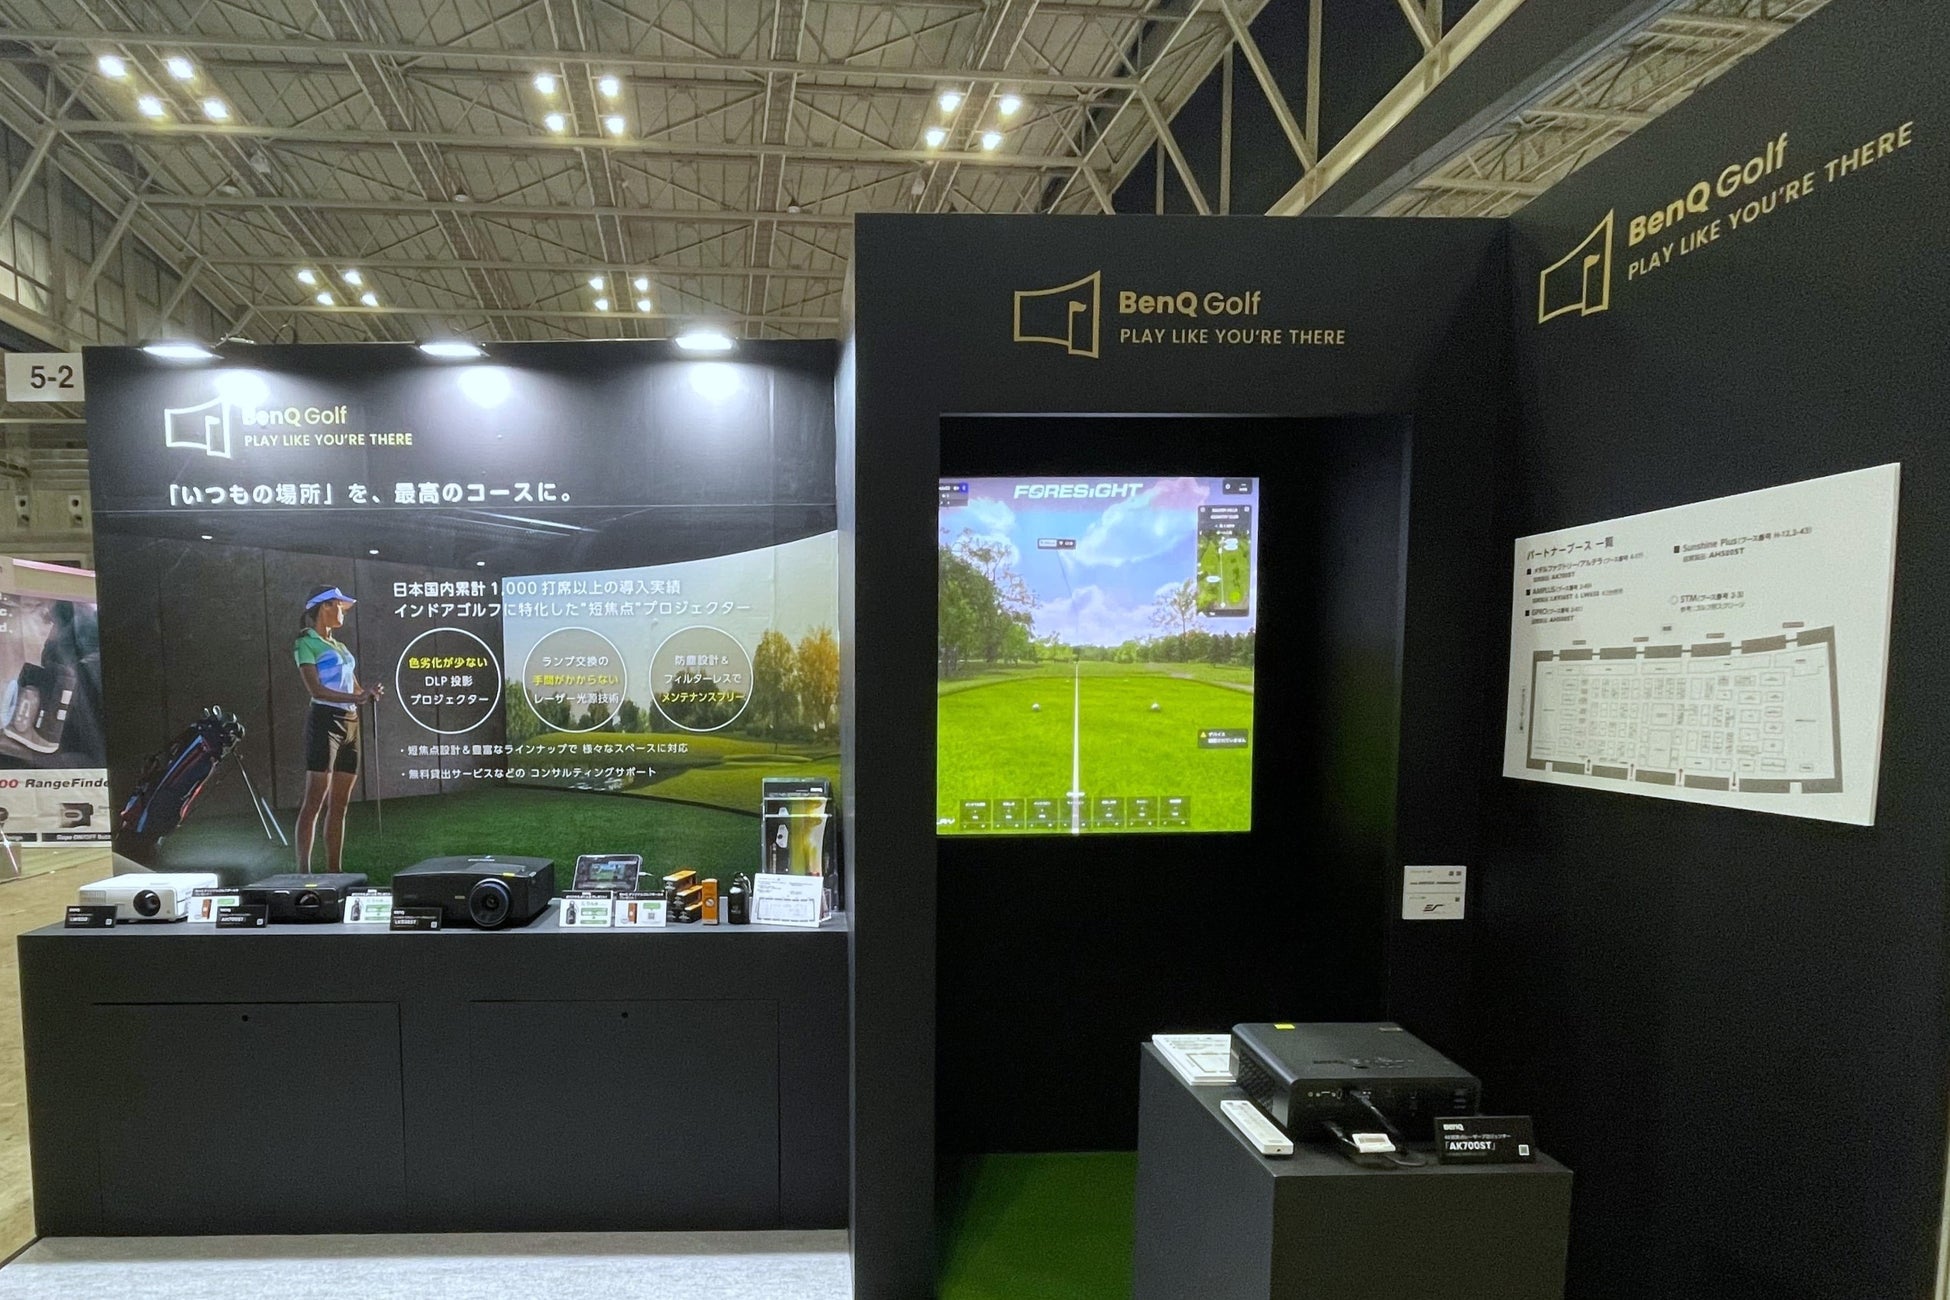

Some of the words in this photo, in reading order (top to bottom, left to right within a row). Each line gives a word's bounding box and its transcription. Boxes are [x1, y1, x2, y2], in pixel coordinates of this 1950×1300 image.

[1628, 180, 1711, 248] BenQ
[1717, 132, 1788, 199] Golf
[1628, 242, 1675, 281] PLAY
[1680, 220, 1722, 256] LIKE
[1729, 172, 1815, 231] YOU'RE
[1824, 121, 1914, 183] THERE
[1119, 291, 1198, 318] BenQ
[1204, 290, 1261, 316] Golf
[1120, 329, 1164, 344] PLAY
[1172, 329, 1208, 344] LIKE
[1216, 329, 1282, 345] YOU'RE
[1289, 330, 1346, 345] THERE
[30, 365, 74, 389] 5-2
[304, 405, 348, 425] Golf
[244, 434, 278, 447] PLAY
[283, 434, 310, 446] LIKE
[315, 433, 365, 446] YOU'RE
[369, 432, 413, 446] THERE
[169, 482, 332, 506] 「いつもの場所」
[348, 483, 381, 504] を、
[394, 482, 573, 505] 最高のコースに。
[393, 581, 486, 598] 日本国内累計
[490, 580, 537, 597] 1,000
[541, 578, 681, 596] 打席以上の導入実績
[408, 656, 488, 669] 色劣化が少ない
[541, 655, 609, 667] ランプ交換の
[425, 676, 447, 688] DLP
[450, 675, 474, 688] 投影
[532, 674, 619, 687] 手間がかからない
[664, 673, 742, 685] フィルターレスで
[410, 693, 489, 706] プロジェクター
[533, 692, 619, 704] レーザー光源技術
[661, 691, 745, 703] メンテナンスフリー
[582, 742, 689, 755] 様々なスペースに対応
[530, 766, 657, 779] コンサルティングサポート
